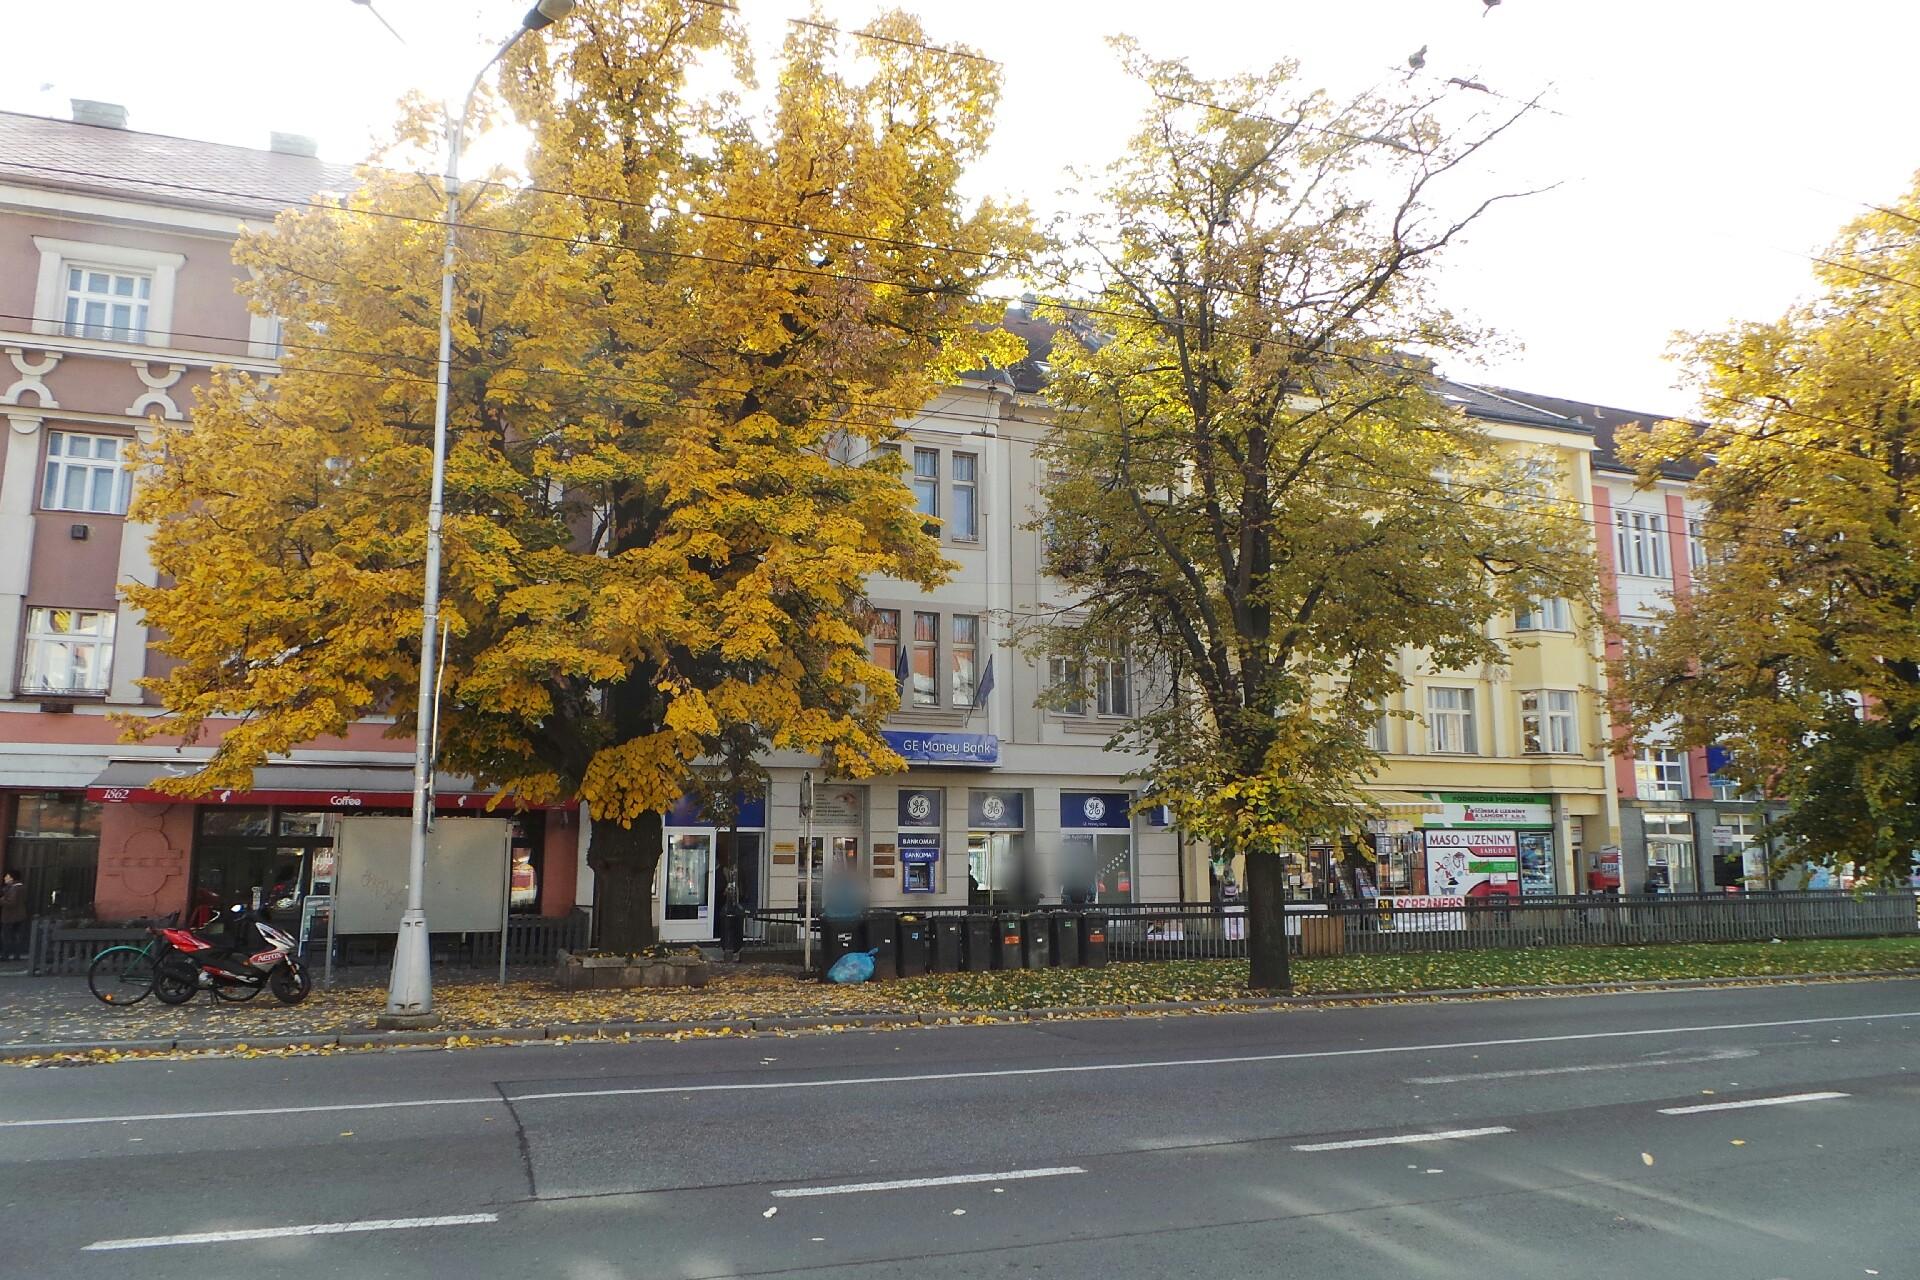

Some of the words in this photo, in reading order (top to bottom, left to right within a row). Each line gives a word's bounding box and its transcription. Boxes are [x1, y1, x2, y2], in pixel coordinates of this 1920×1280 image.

[903, 739, 919, 751] GE
[922, 741, 960, 755] Money
[963, 742, 991, 754] Bank
[103, 788, 129, 799] 1862
[330, 795, 361, 805] Coffee
[1429, 834, 1460, 846] MASO
[1467, 834, 1511, 846] UZENINY
[1396, 897, 1463, 909] SCREAMERS
